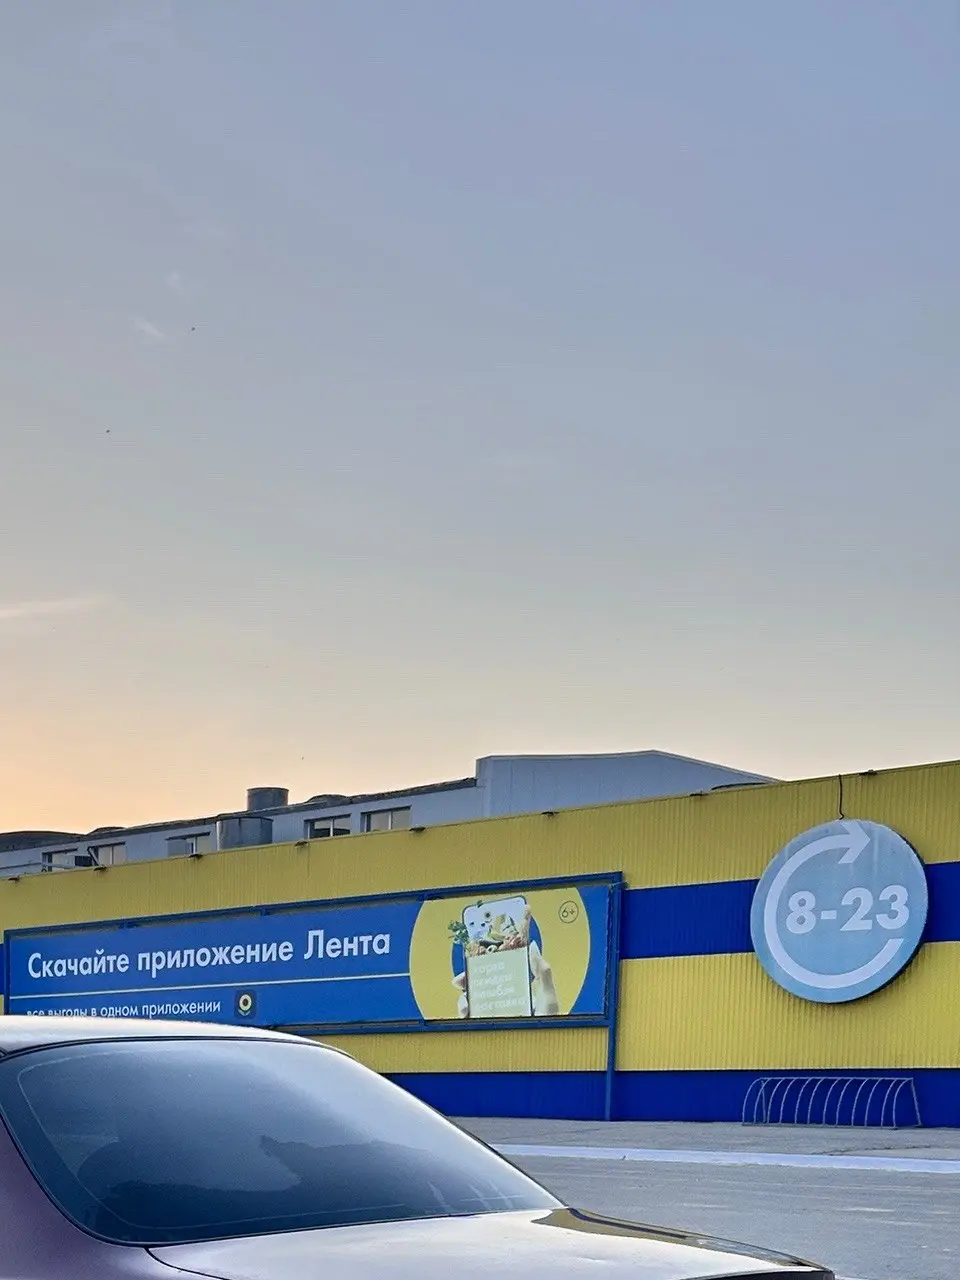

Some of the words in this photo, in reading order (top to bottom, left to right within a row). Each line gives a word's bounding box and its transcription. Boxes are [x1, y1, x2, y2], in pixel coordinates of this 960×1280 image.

[785, 885, 910, 934] 8-23
[28, 948, 130, 979] Скачайте
[138, 941, 294, 979] приложение
[304, 929, 390, 960] Лента
[91, 1006, 98, 1017] в
[100, 1003, 139, 1019] одном
[142, 1001, 221, 1019] приложении
